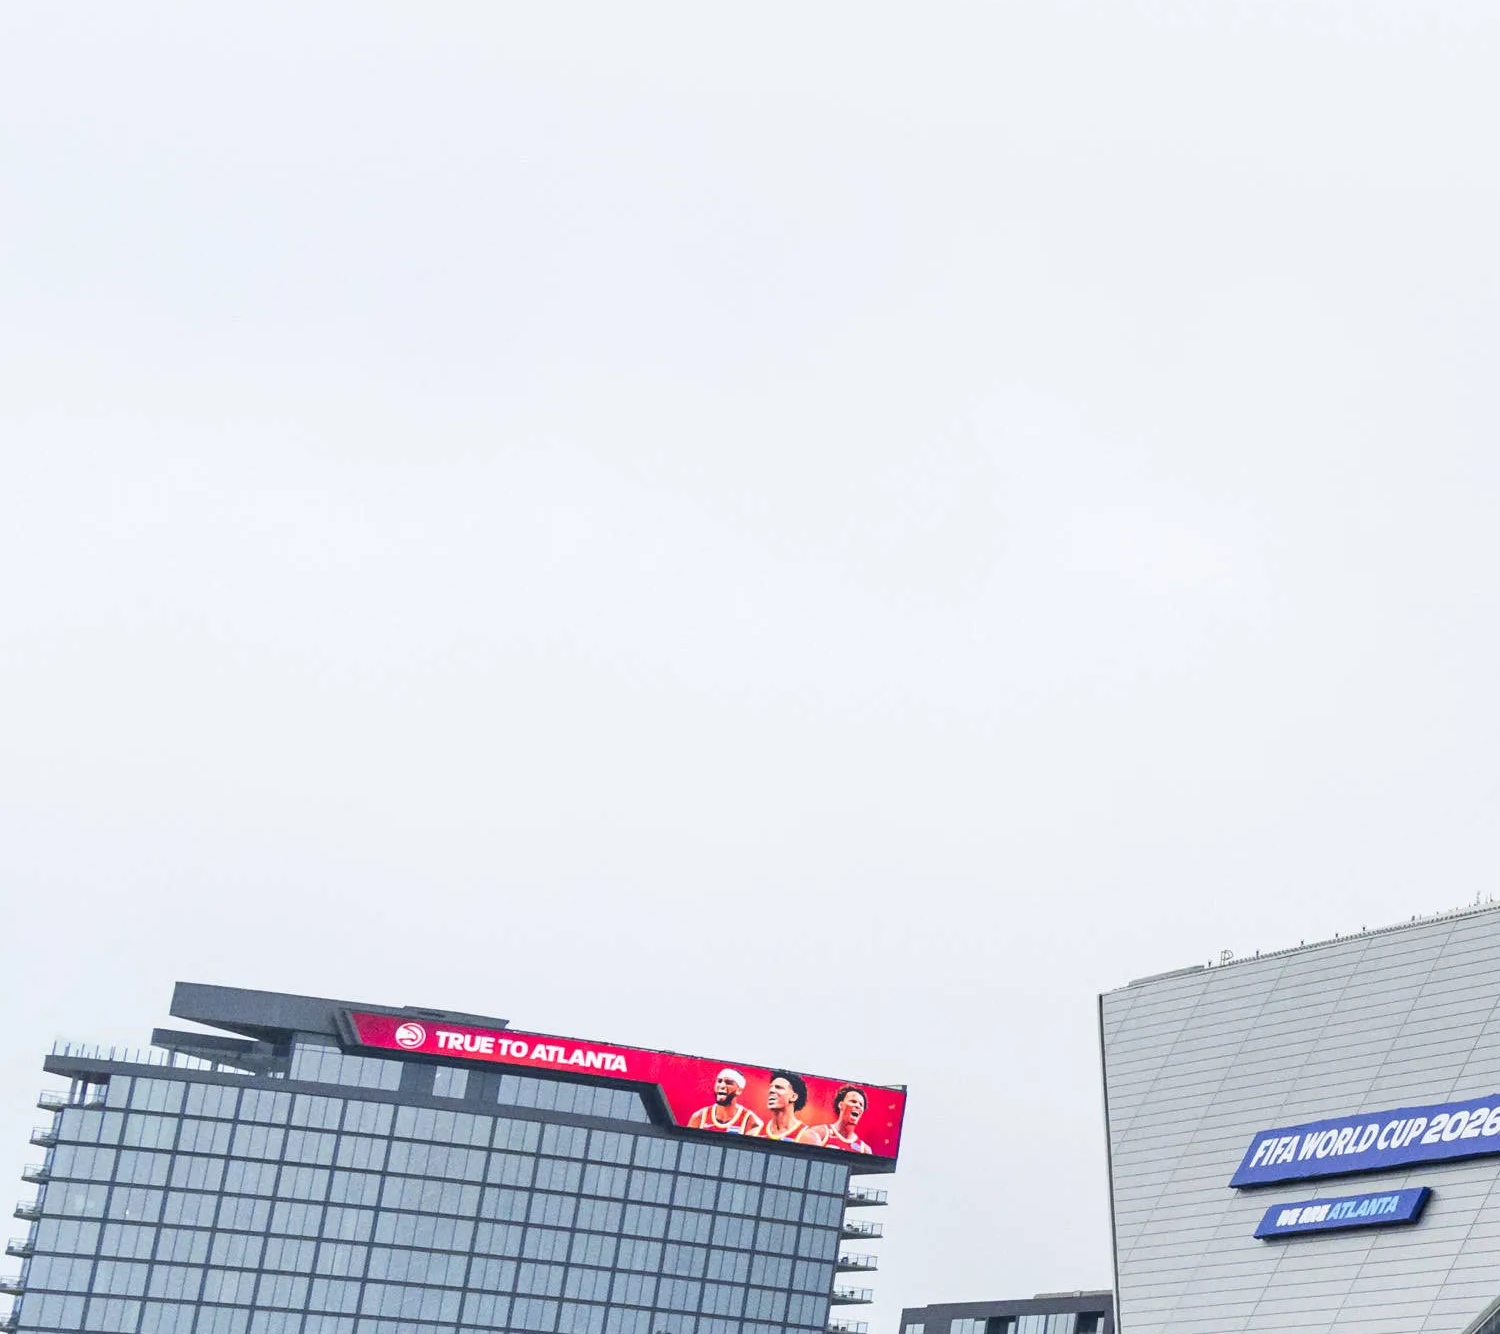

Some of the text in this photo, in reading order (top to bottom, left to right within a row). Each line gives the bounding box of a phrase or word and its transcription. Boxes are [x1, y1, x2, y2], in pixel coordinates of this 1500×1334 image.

[436, 1031, 627, 1072] TRUE TO ATLANTA
[1250, 1135, 1298, 1167] FIFA
[1299, 1124, 1380, 1161] WORLD
[1376, 1117, 1428, 1150] CUP
[1276, 1208, 1302, 1227] WE
[1327, 1195, 1399, 1220] ATLANTA
